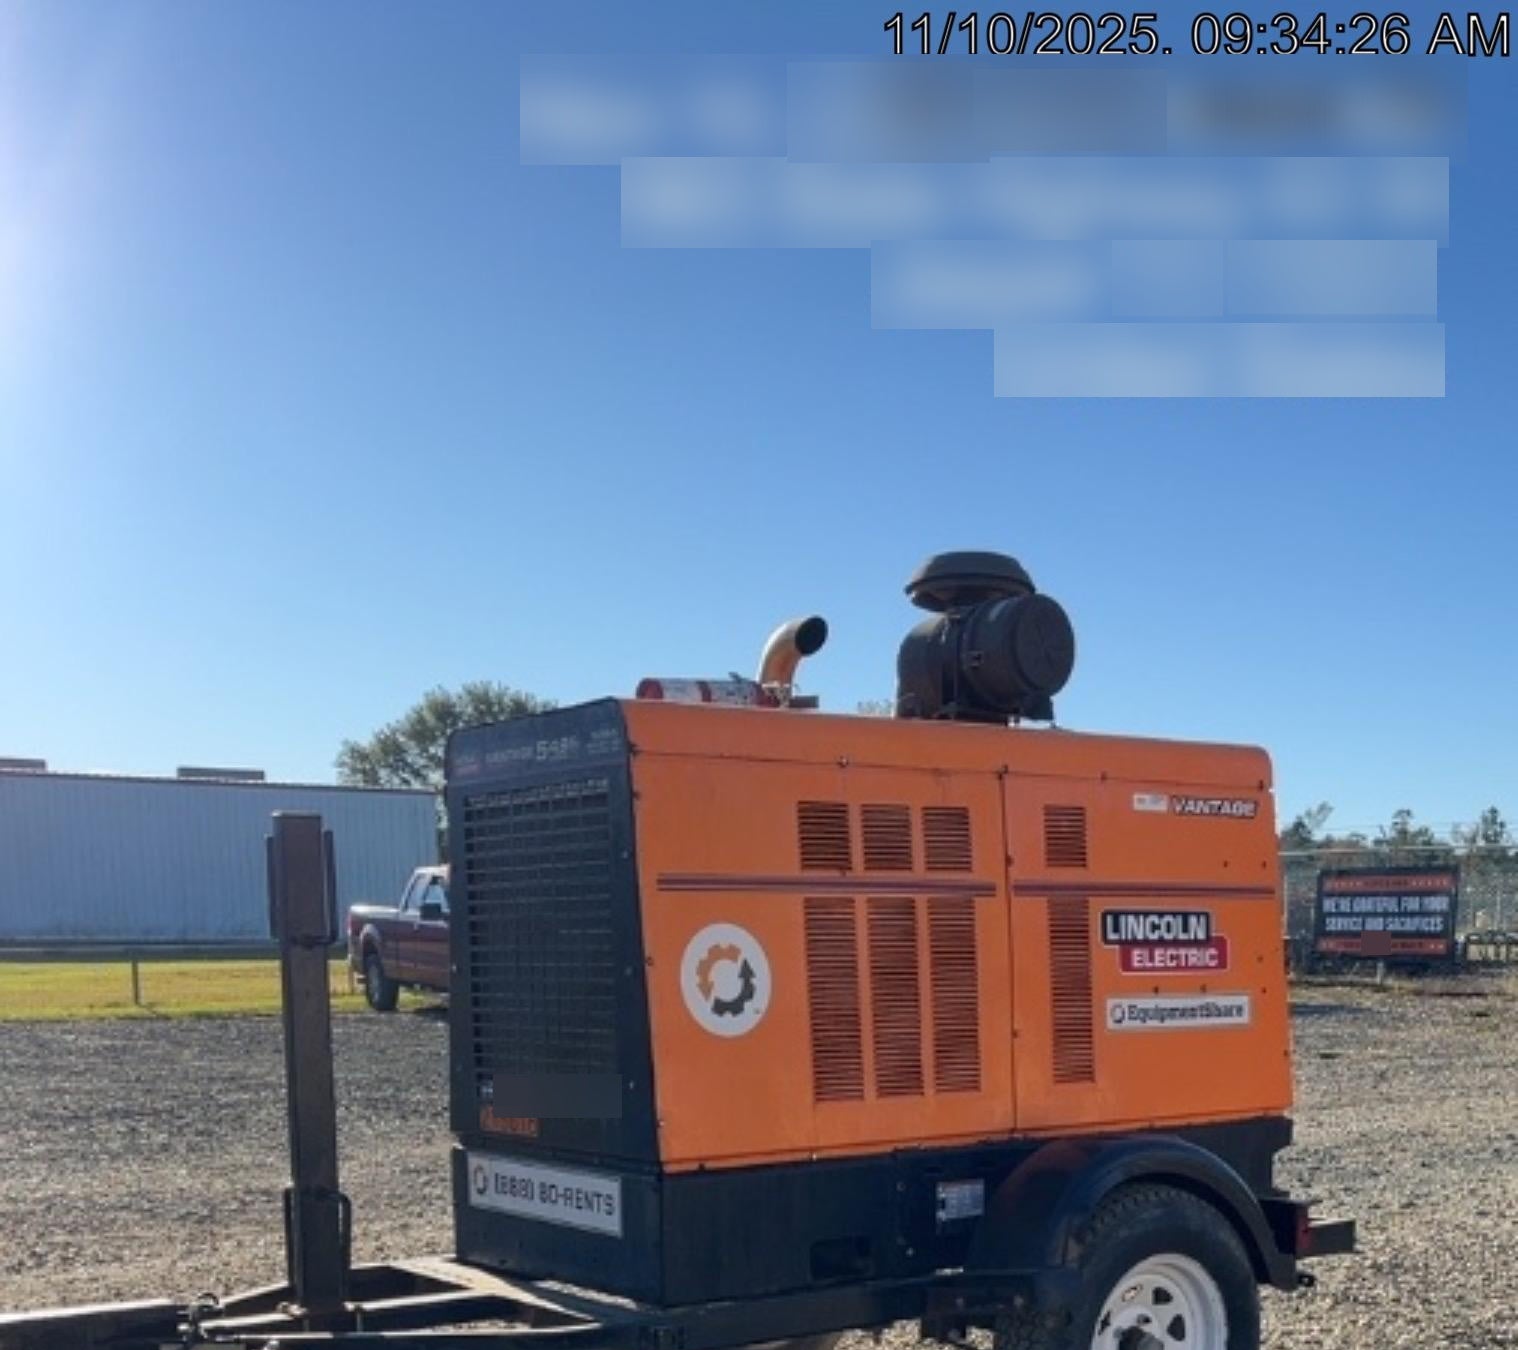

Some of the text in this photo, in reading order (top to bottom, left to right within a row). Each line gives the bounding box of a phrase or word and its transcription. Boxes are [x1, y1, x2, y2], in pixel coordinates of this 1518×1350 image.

[1173, 798, 1256, 817] VANTAGE
[1352, 896, 1398, 912] GRATEFUL
[1401, 896, 1420, 912] FOR
[1421, 896, 1449, 912] YOUR
[1105, 913, 1208, 941] LINCOLN
[1325, 916, 1362, 931] SERVICE
[1364, 916, 1384, 931] AND
[1131, 947, 1219, 967] ELECTRIC
[1127, 1002, 1244, 1023] EquipmentShare
